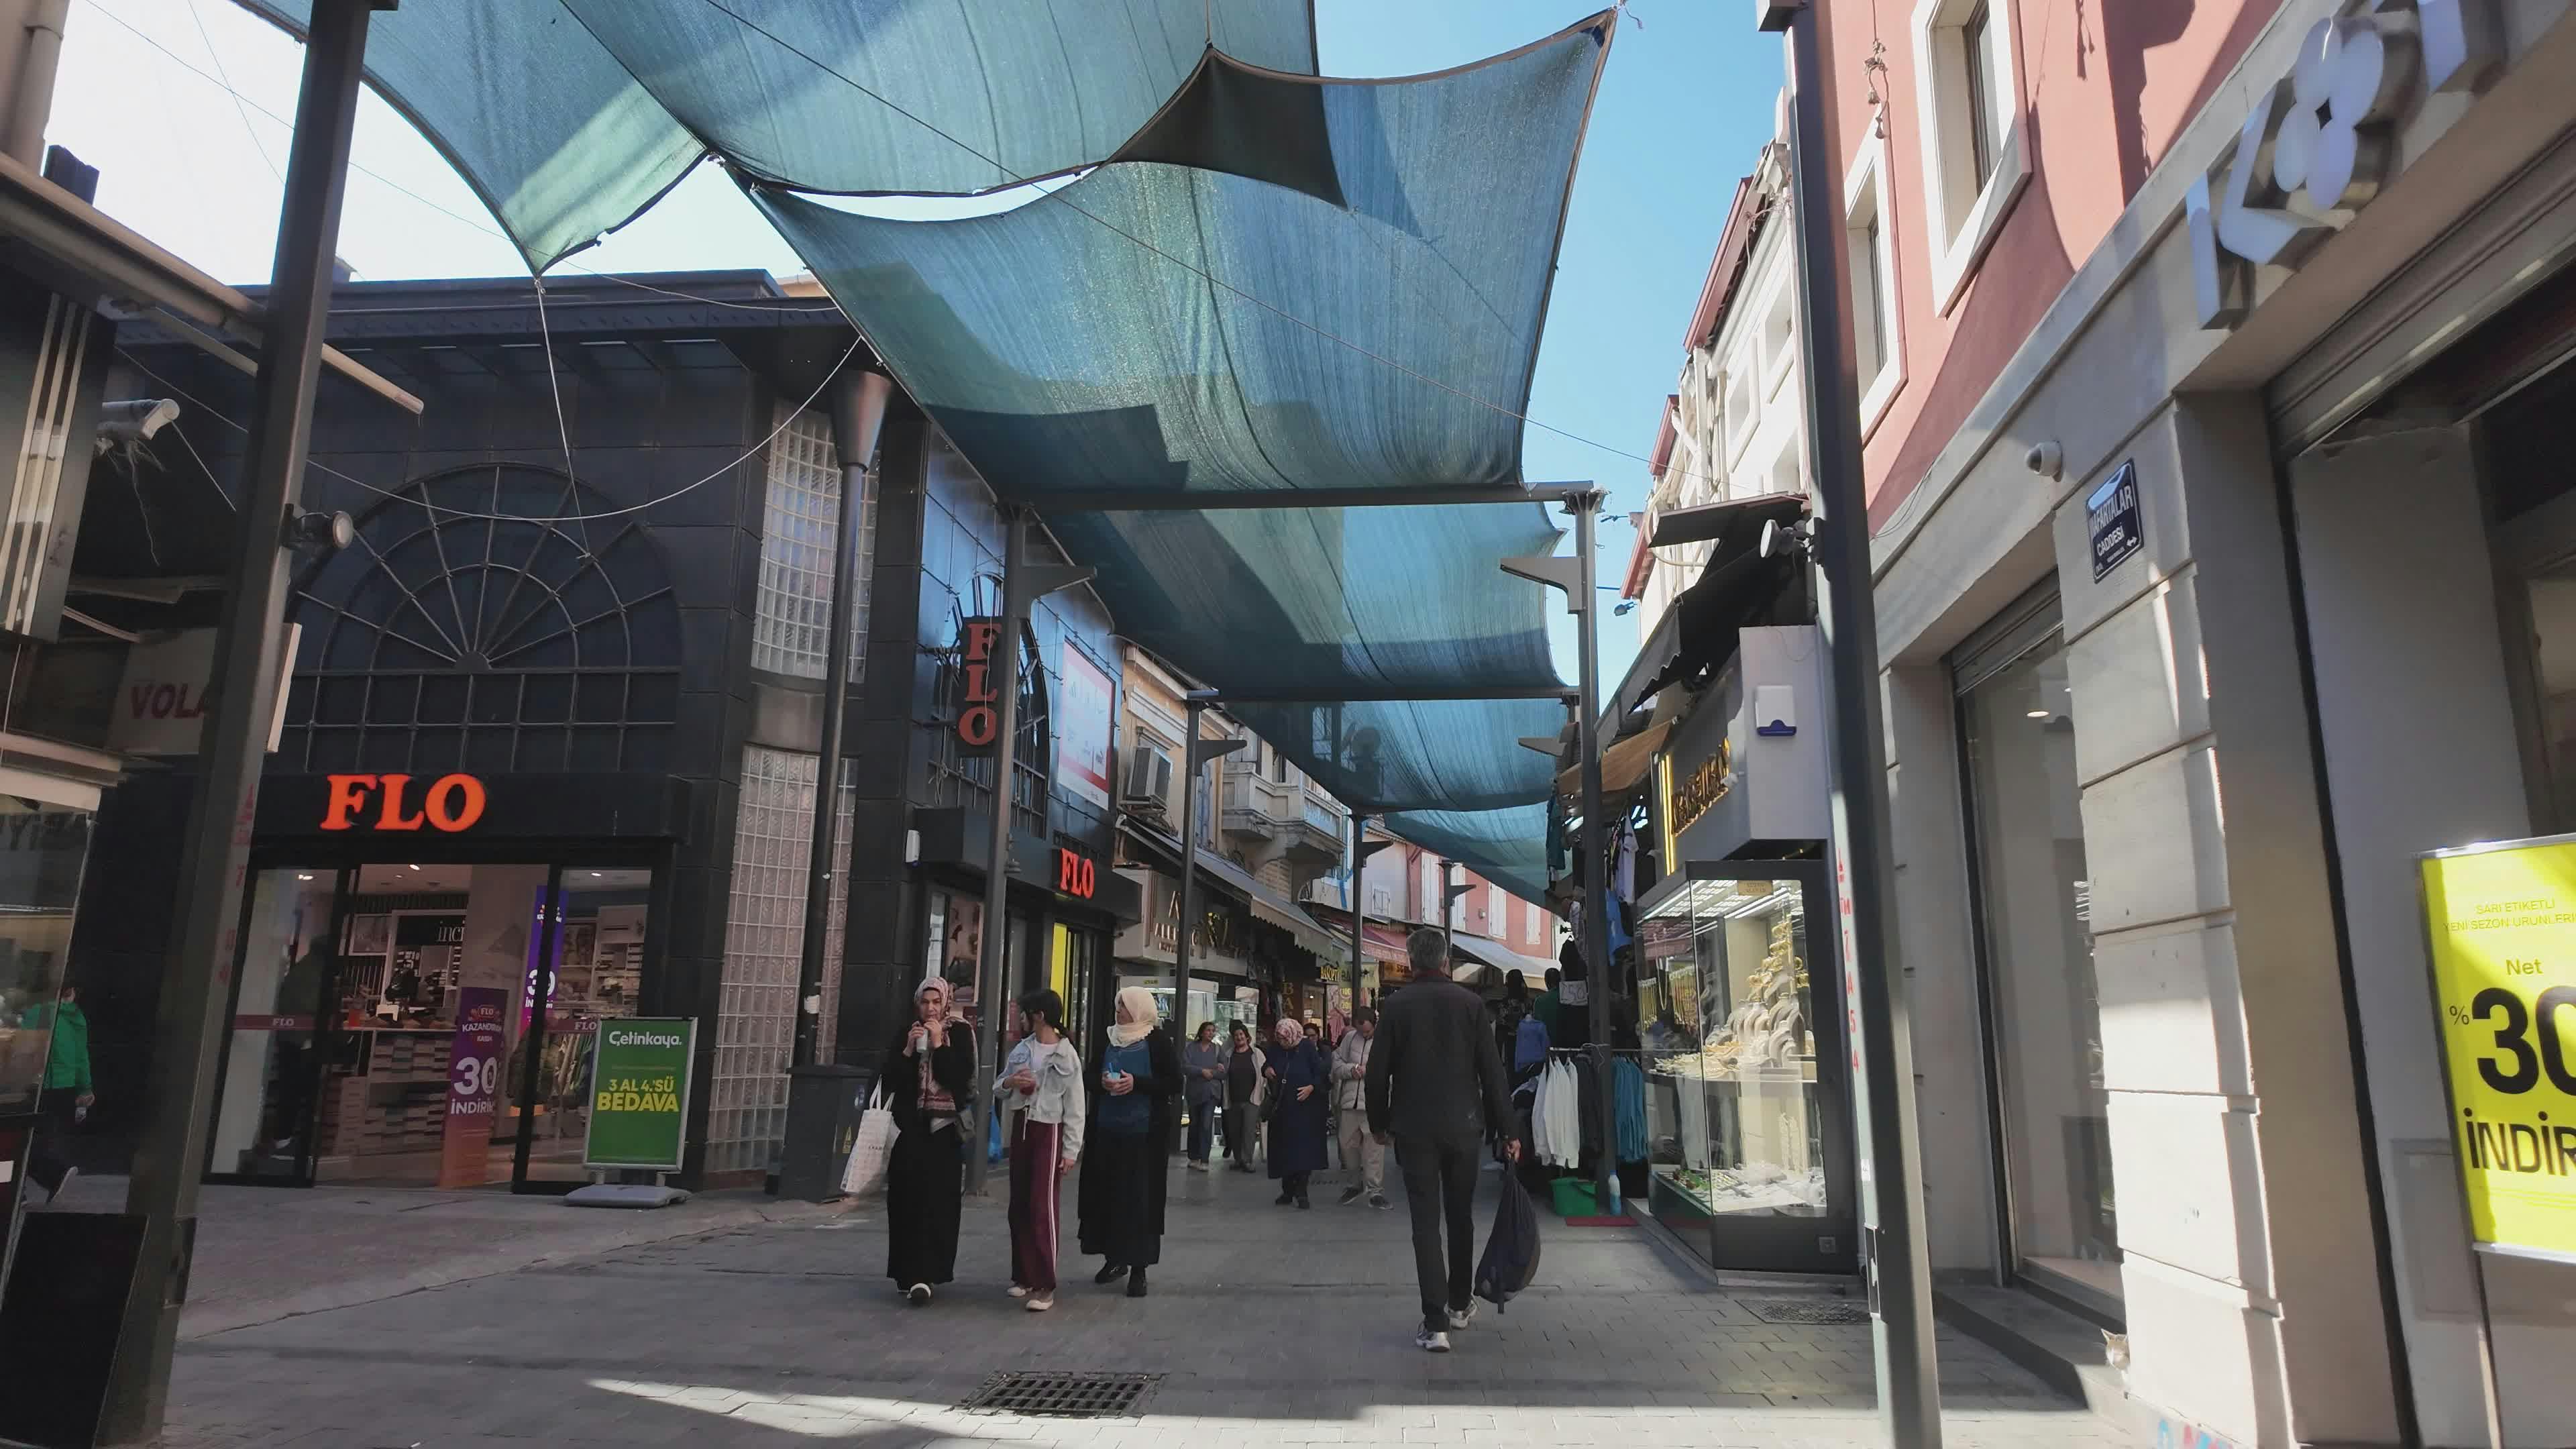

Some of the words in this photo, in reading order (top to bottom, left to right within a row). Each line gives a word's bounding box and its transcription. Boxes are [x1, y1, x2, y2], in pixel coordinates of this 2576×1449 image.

[2088, 485, 2133, 539] AFARTALAR
[2096, 523, 2126, 557] CADDESİ
[959, 622, 1002, 746] FLO
[320, 773, 487, 833] FLO
[1060, 848, 1095, 900] FLO
[2506, 958, 2542, 976] Net
[272, 1018, 294, 1026] FLO
[574, 1021, 597, 1030] FLO
[453, 1057, 498, 1095] 30
[609, 1079, 617, 1091] 3
[620, 1079, 637, 1091] AL
[597, 1092, 680, 1112] BEDAVA
[2463, 1107, 2576, 1177] İNDİR
